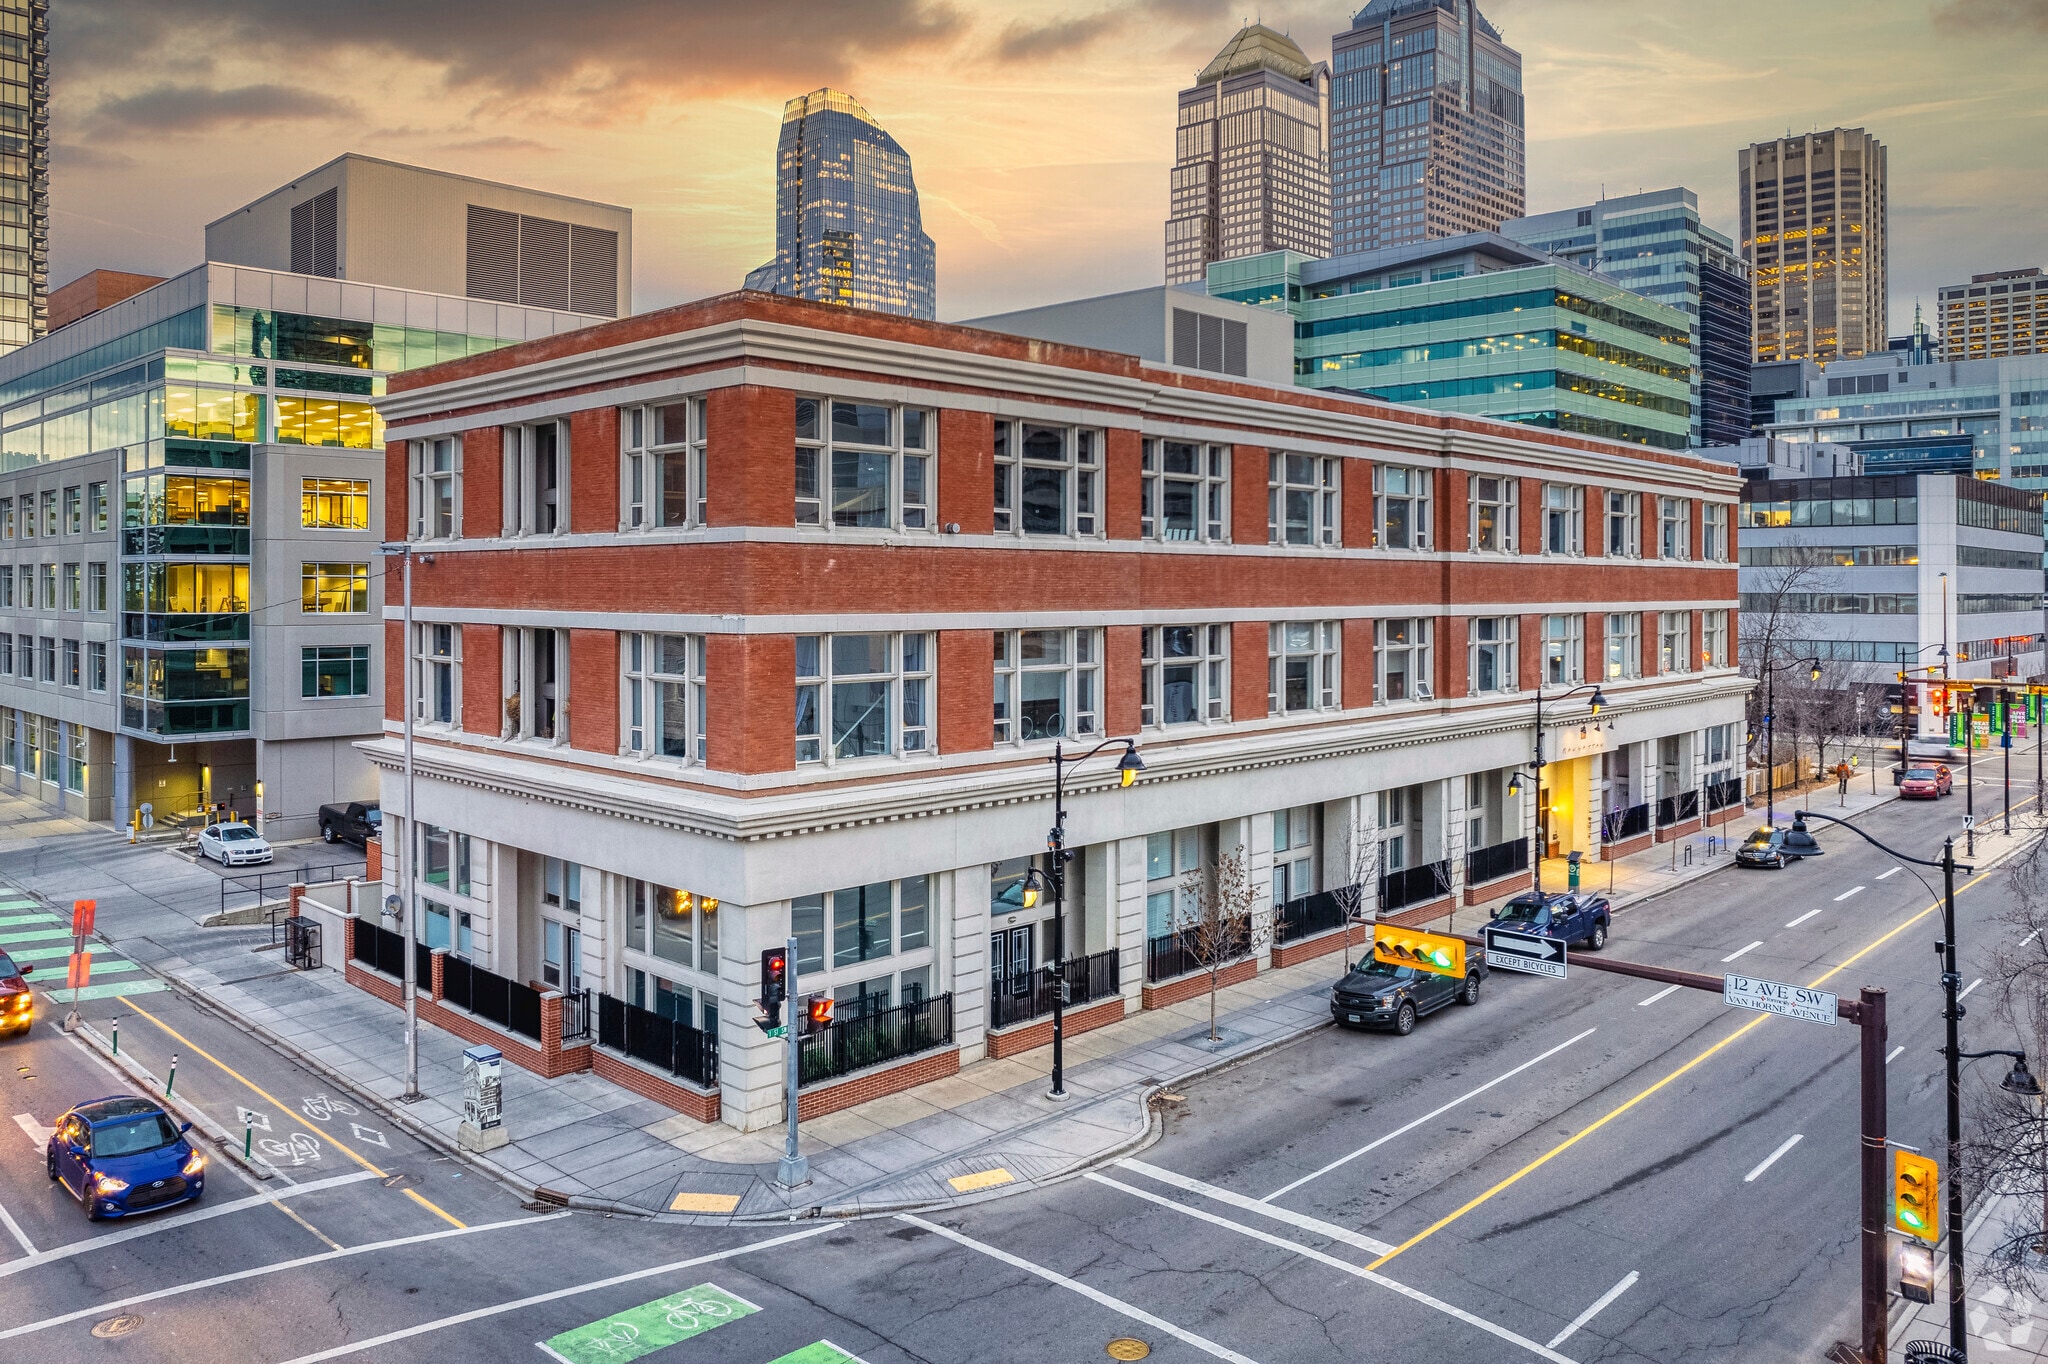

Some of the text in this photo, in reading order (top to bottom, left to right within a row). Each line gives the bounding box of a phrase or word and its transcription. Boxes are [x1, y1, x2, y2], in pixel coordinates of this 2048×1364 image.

[1496, 955, 1556, 974] EXCEPT BICYCLES
[1734, 978, 1748, 991] 12
[1755, 982, 1788, 999] AVE
[1728, 995, 1831, 1022] VAN HORNE AVENUE
